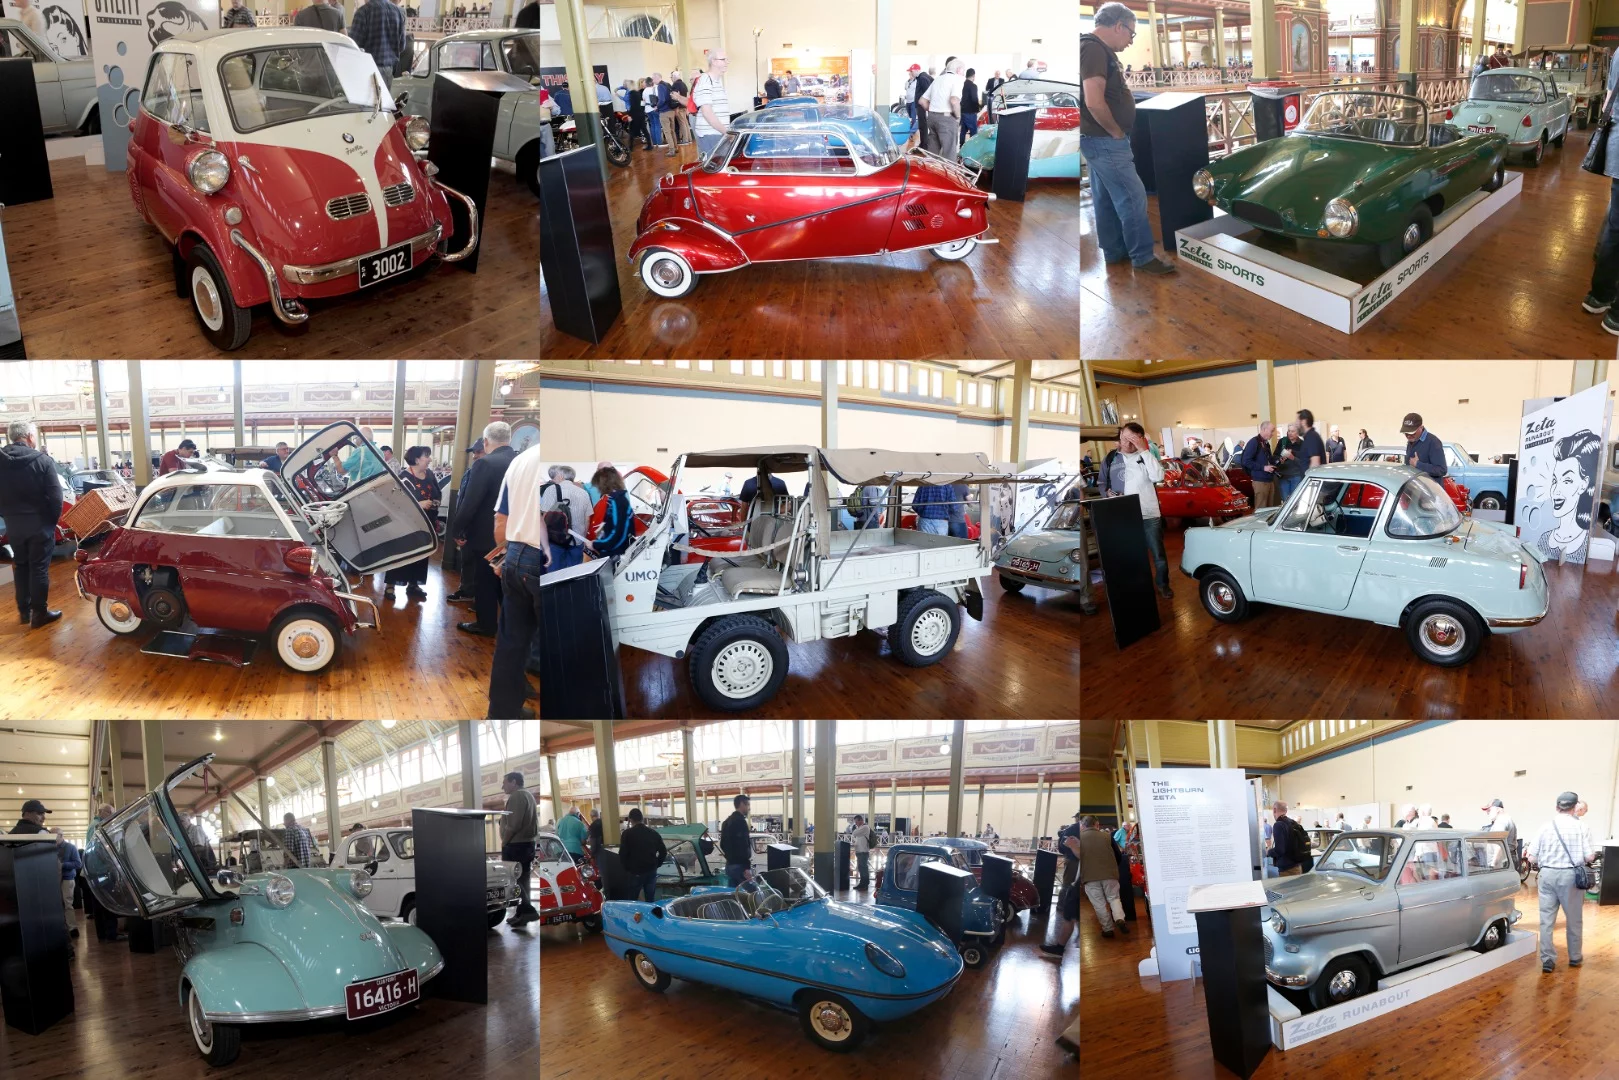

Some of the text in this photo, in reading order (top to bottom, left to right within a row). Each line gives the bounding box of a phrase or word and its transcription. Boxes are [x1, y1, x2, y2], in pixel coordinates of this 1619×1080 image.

[372, 251, 405, 279] 3002
[1180, 238, 1212, 261] Zeta
[1217, 258, 1265, 287] SPORTS
[1357, 282, 1393, 315] Zeta
[1397, 252, 1429, 285] SPORTS
[1525, 416, 1556, 436] Zeta
[1290, 1014, 1337, 1036] Zeta
[1342, 989, 1410, 1020] RUNABOUT
